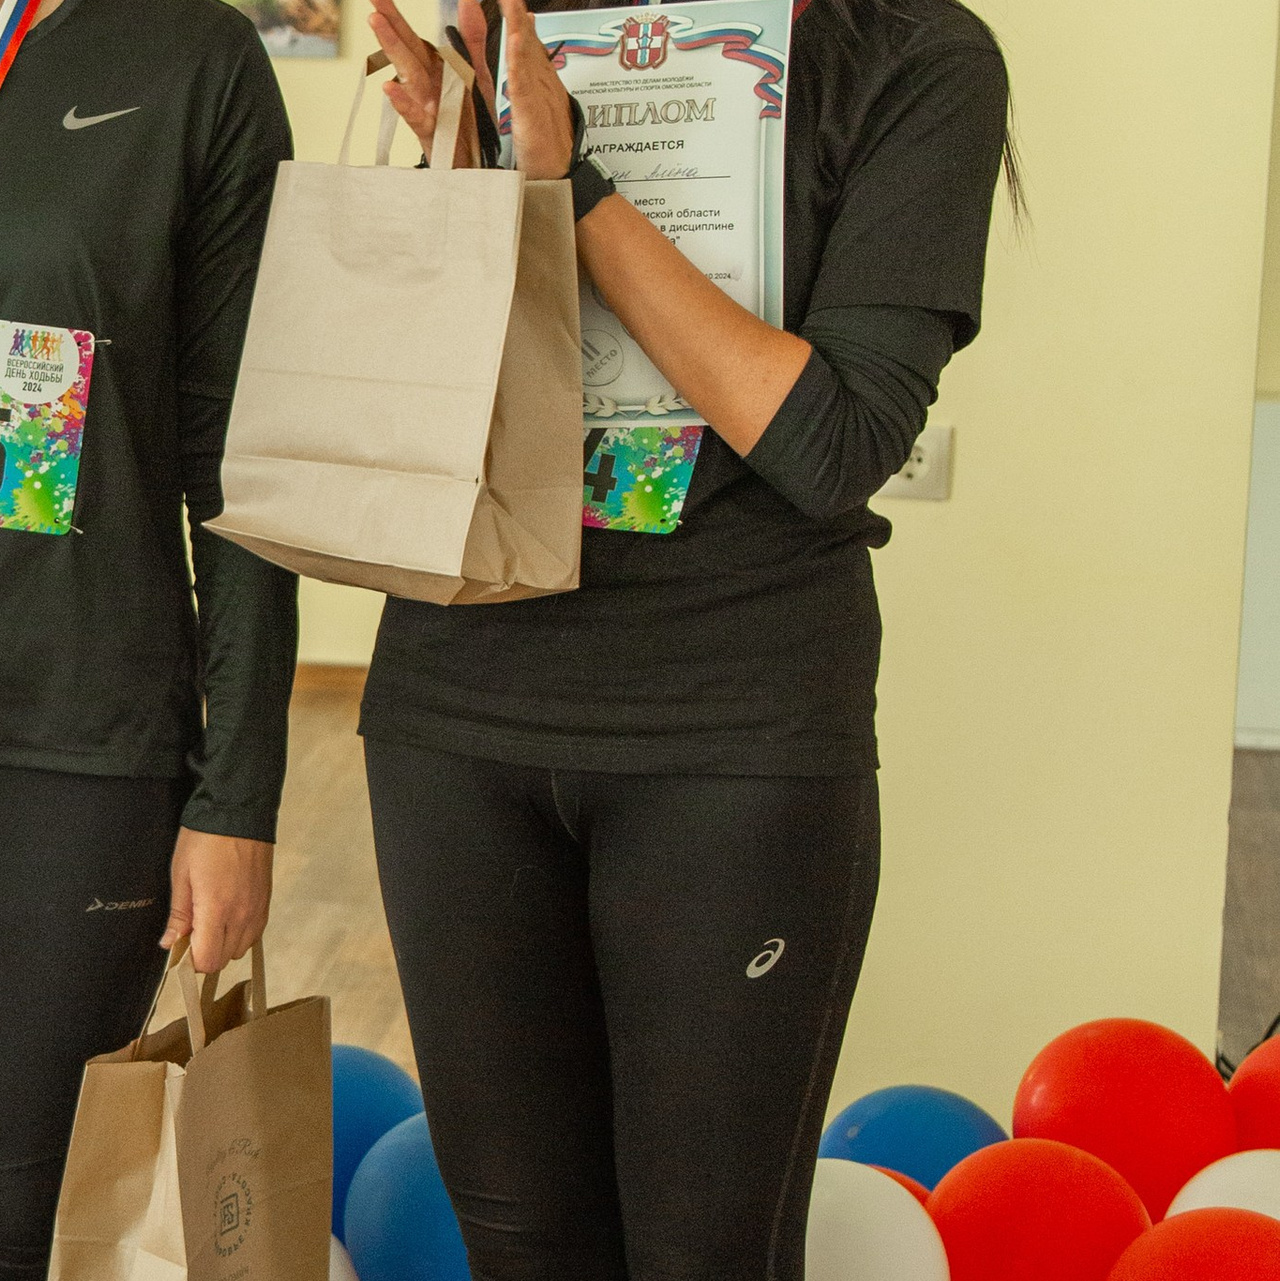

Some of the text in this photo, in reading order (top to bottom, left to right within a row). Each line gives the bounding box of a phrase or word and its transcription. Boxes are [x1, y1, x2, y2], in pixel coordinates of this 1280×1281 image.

[571, 87, 607, 95] ФИЗИЧЕСКОЙ
[607, 85, 634, 94] КУЛЬТУРЫ
[640, 84, 661, 92] СПОРТА
[661, 82, 686, 90] ОМСКОЙ
[589, 79, 632, 88] МИНИСТЕРСТВО
[586, 97, 716, 128] ИПЛОМ
[634, 197, 666, 206] место
[642, 208, 720, 219] мской области
[660, 222, 734, 232] в дисциплине
[6, 358, 64, 372] ВСЕРОССИЙСКИЙ
[586, 348, 618, 379] МЕСТО
[4, 367, 63, 383] ДЕНЬ ХОДЬБЫ
[22, 381, 42, 392] 2024
